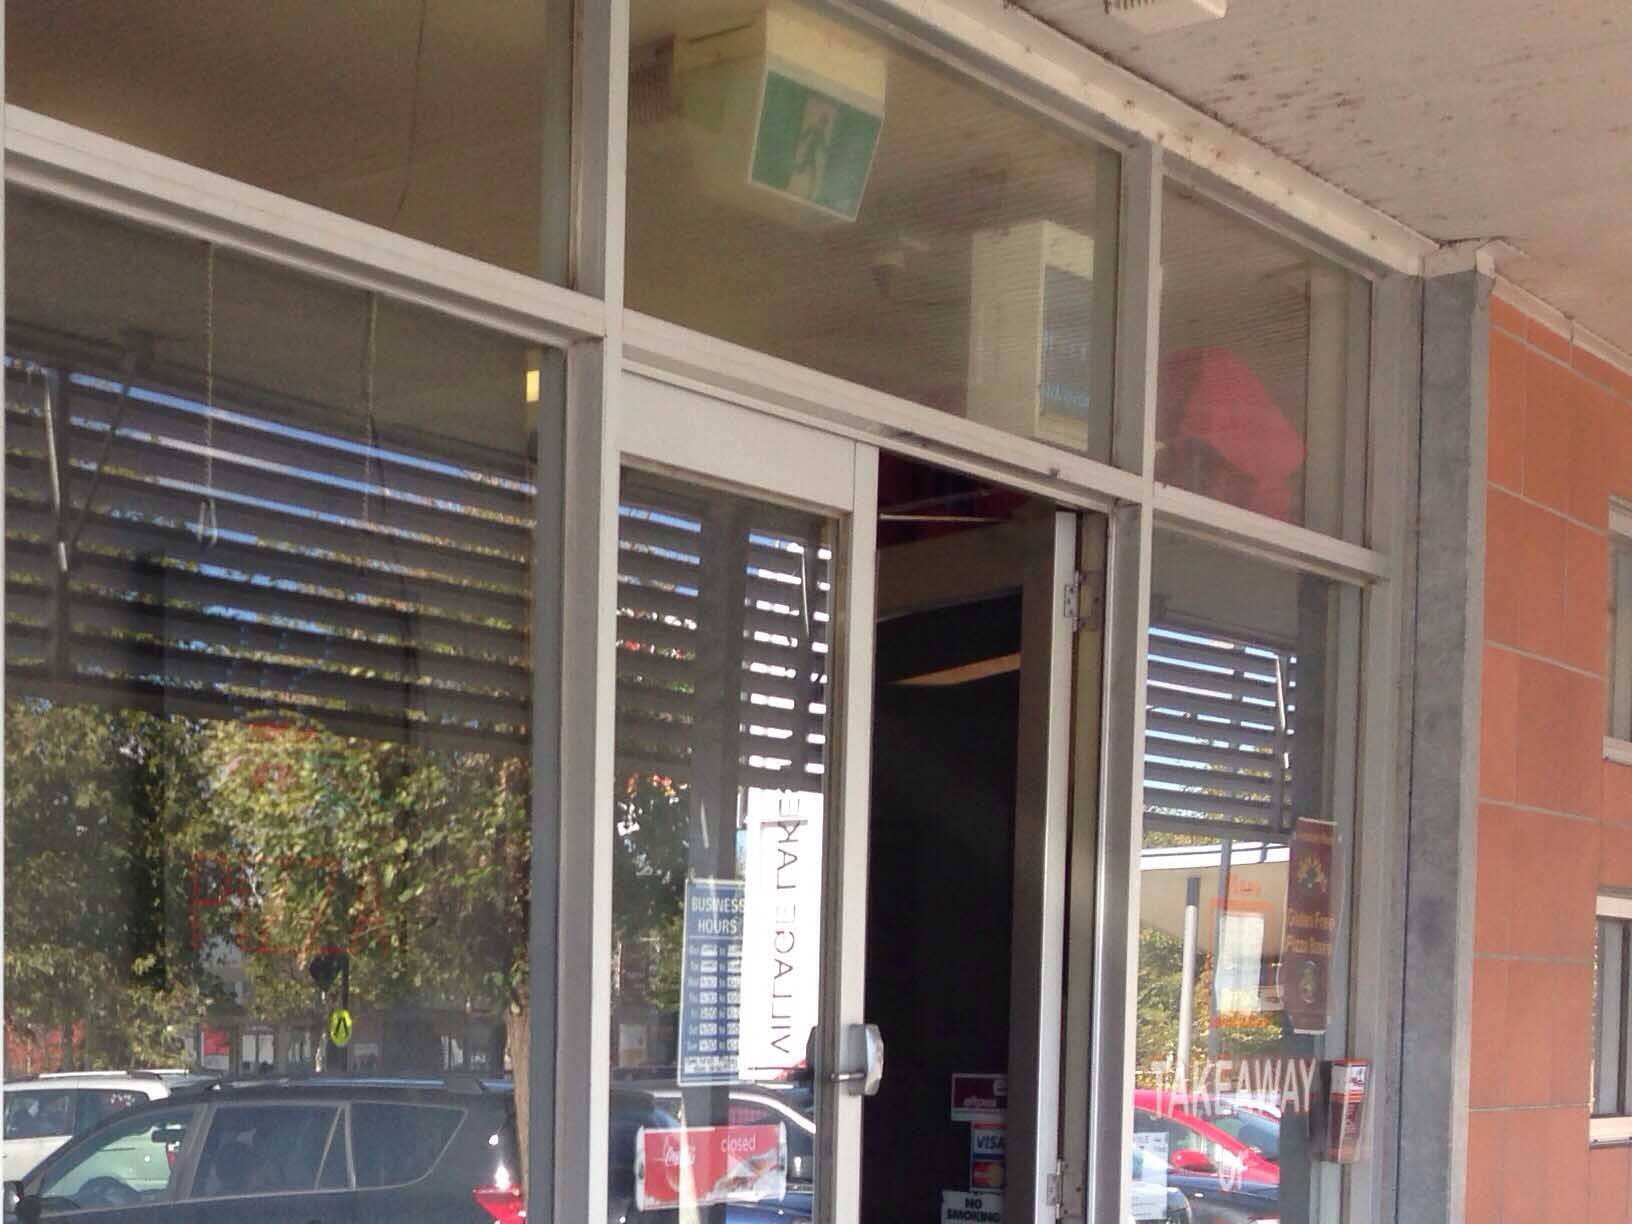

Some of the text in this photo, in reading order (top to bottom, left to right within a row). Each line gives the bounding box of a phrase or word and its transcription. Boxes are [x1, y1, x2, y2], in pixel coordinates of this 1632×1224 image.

[691, 896, 745, 913] BUSINESS
[698, 919, 737, 934] HOURS
[1151, 1058, 1316, 1119] TAKEAWAY
[721, 1133, 756, 1152] closed
[965, 1198, 982, 1209] NO
[946, 1208, 1000, 1223] SMOKING
